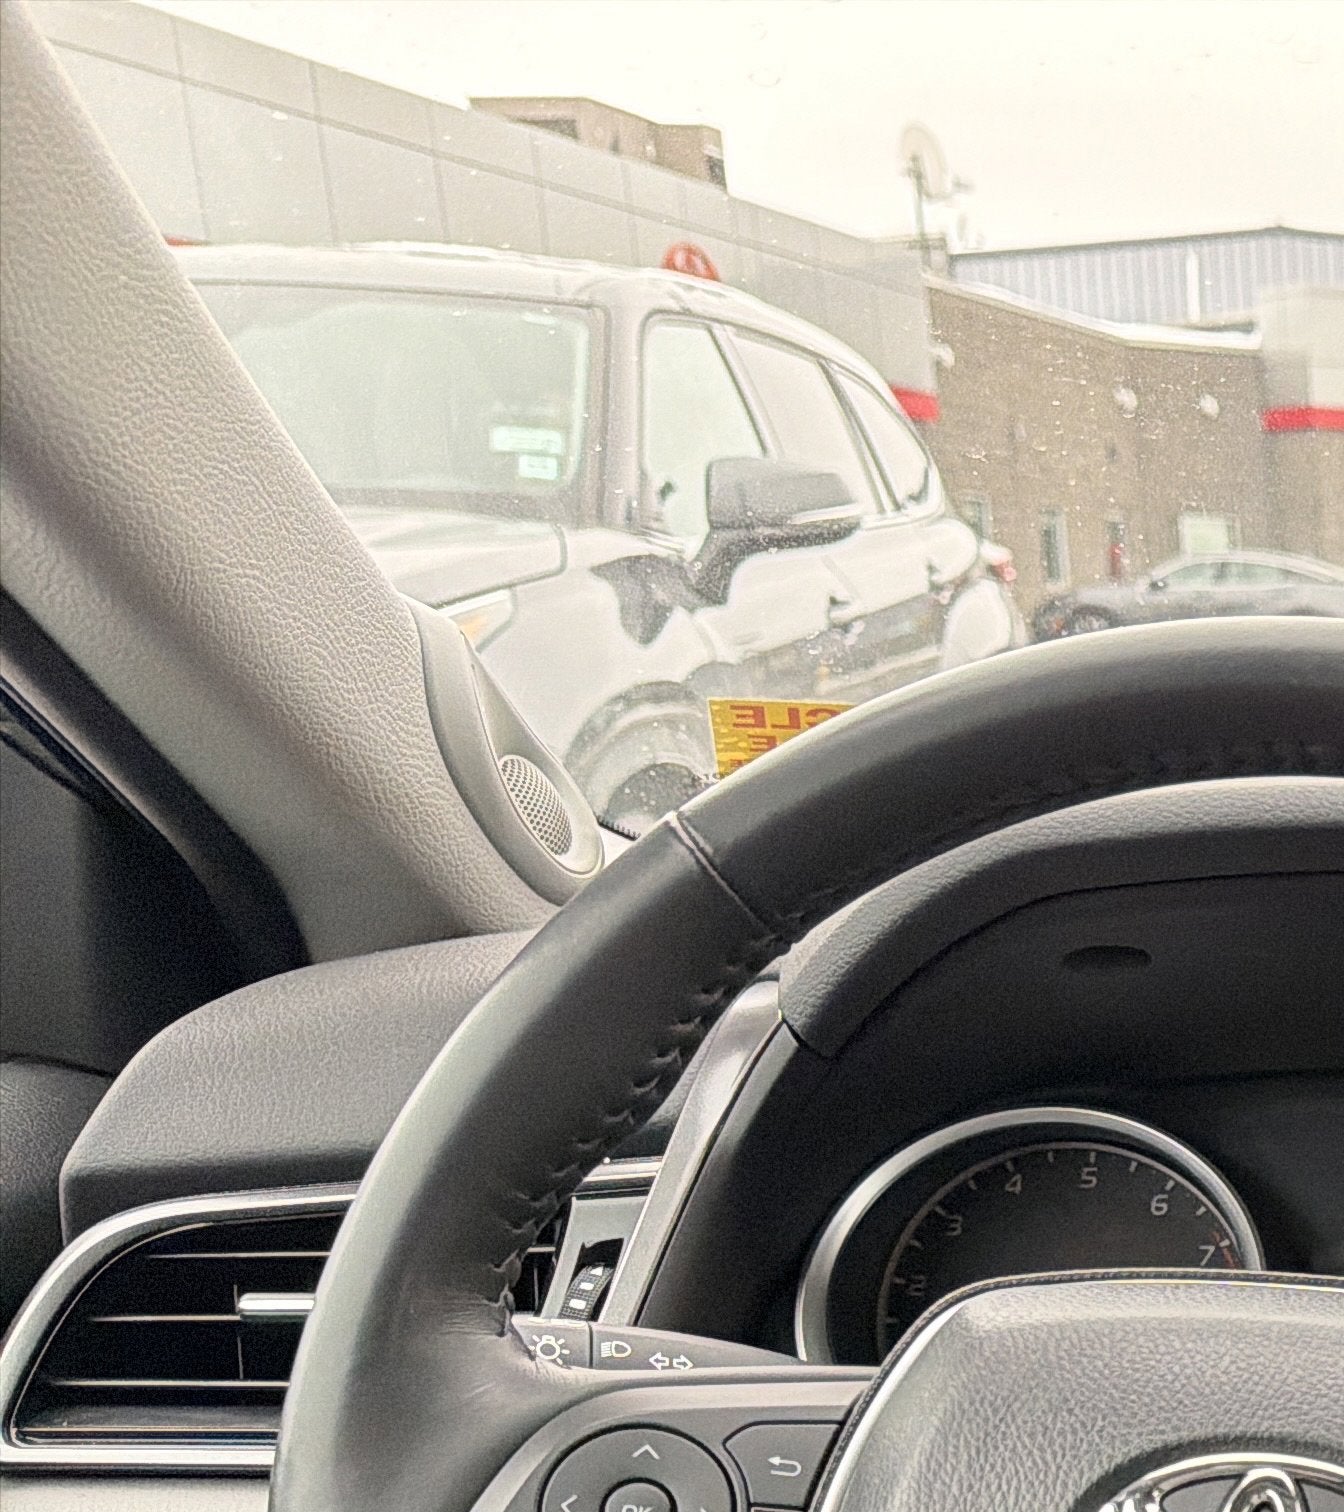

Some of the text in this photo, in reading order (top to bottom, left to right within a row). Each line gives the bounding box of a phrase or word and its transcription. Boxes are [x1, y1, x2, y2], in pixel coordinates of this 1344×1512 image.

[1005, 1174, 1021, 1194] 4
[1080, 1167, 1097, 1188] 5
[1151, 1194, 1168, 1215] 6
[945, 1214, 963, 1236] 3
[1200, 1246, 1215, 1266] 7
